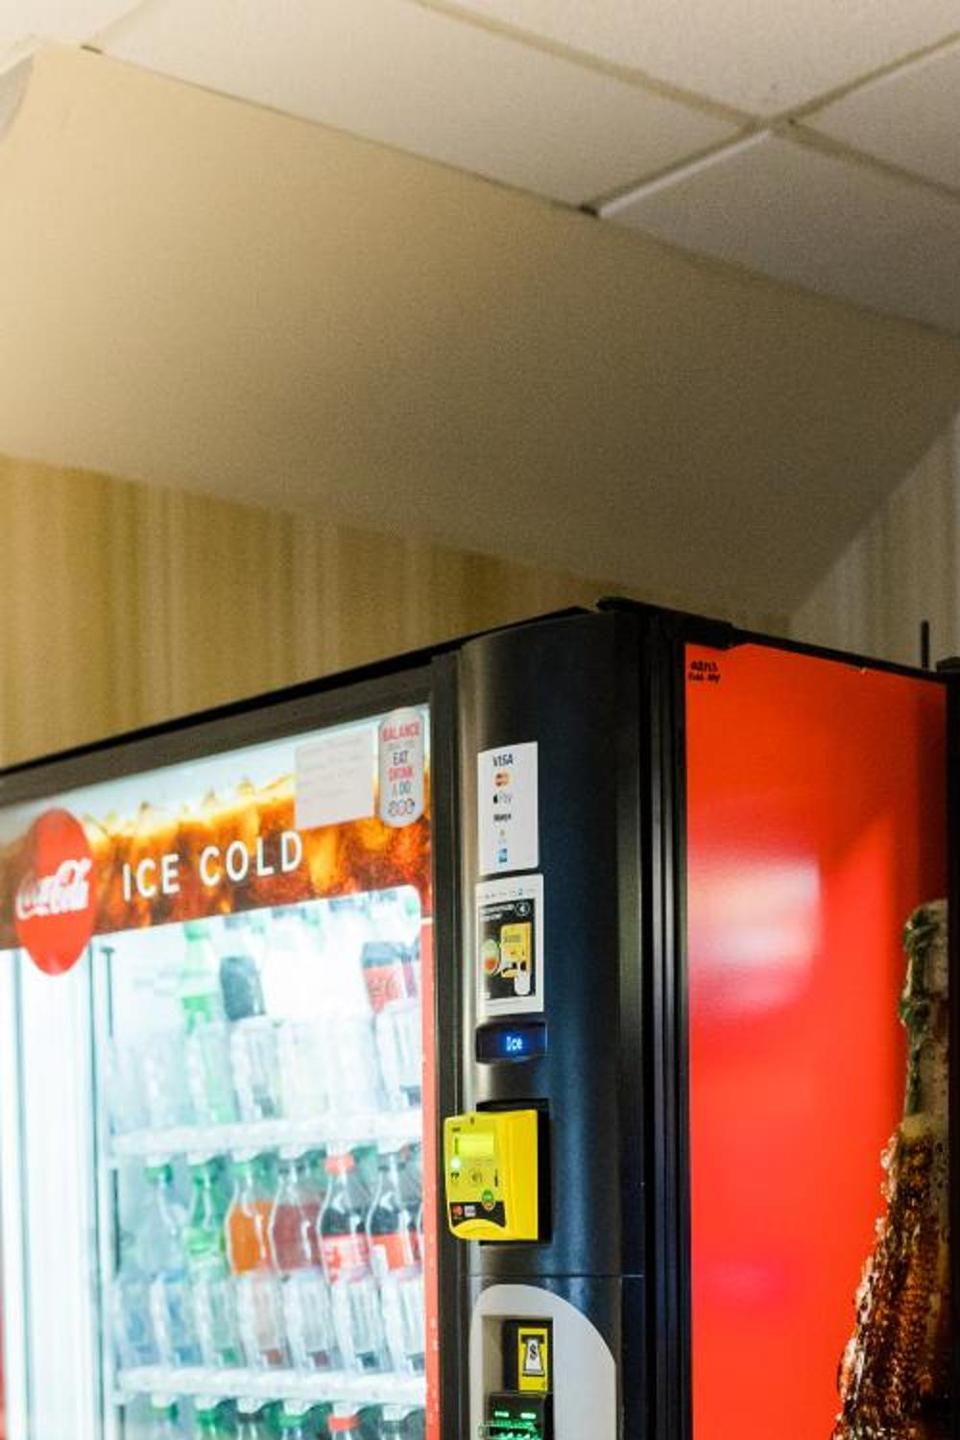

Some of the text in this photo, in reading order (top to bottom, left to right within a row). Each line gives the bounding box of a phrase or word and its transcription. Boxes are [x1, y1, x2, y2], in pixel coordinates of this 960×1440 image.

[493, 753, 513, 768] VISA
[122, 830, 303, 900] ICE COLD
